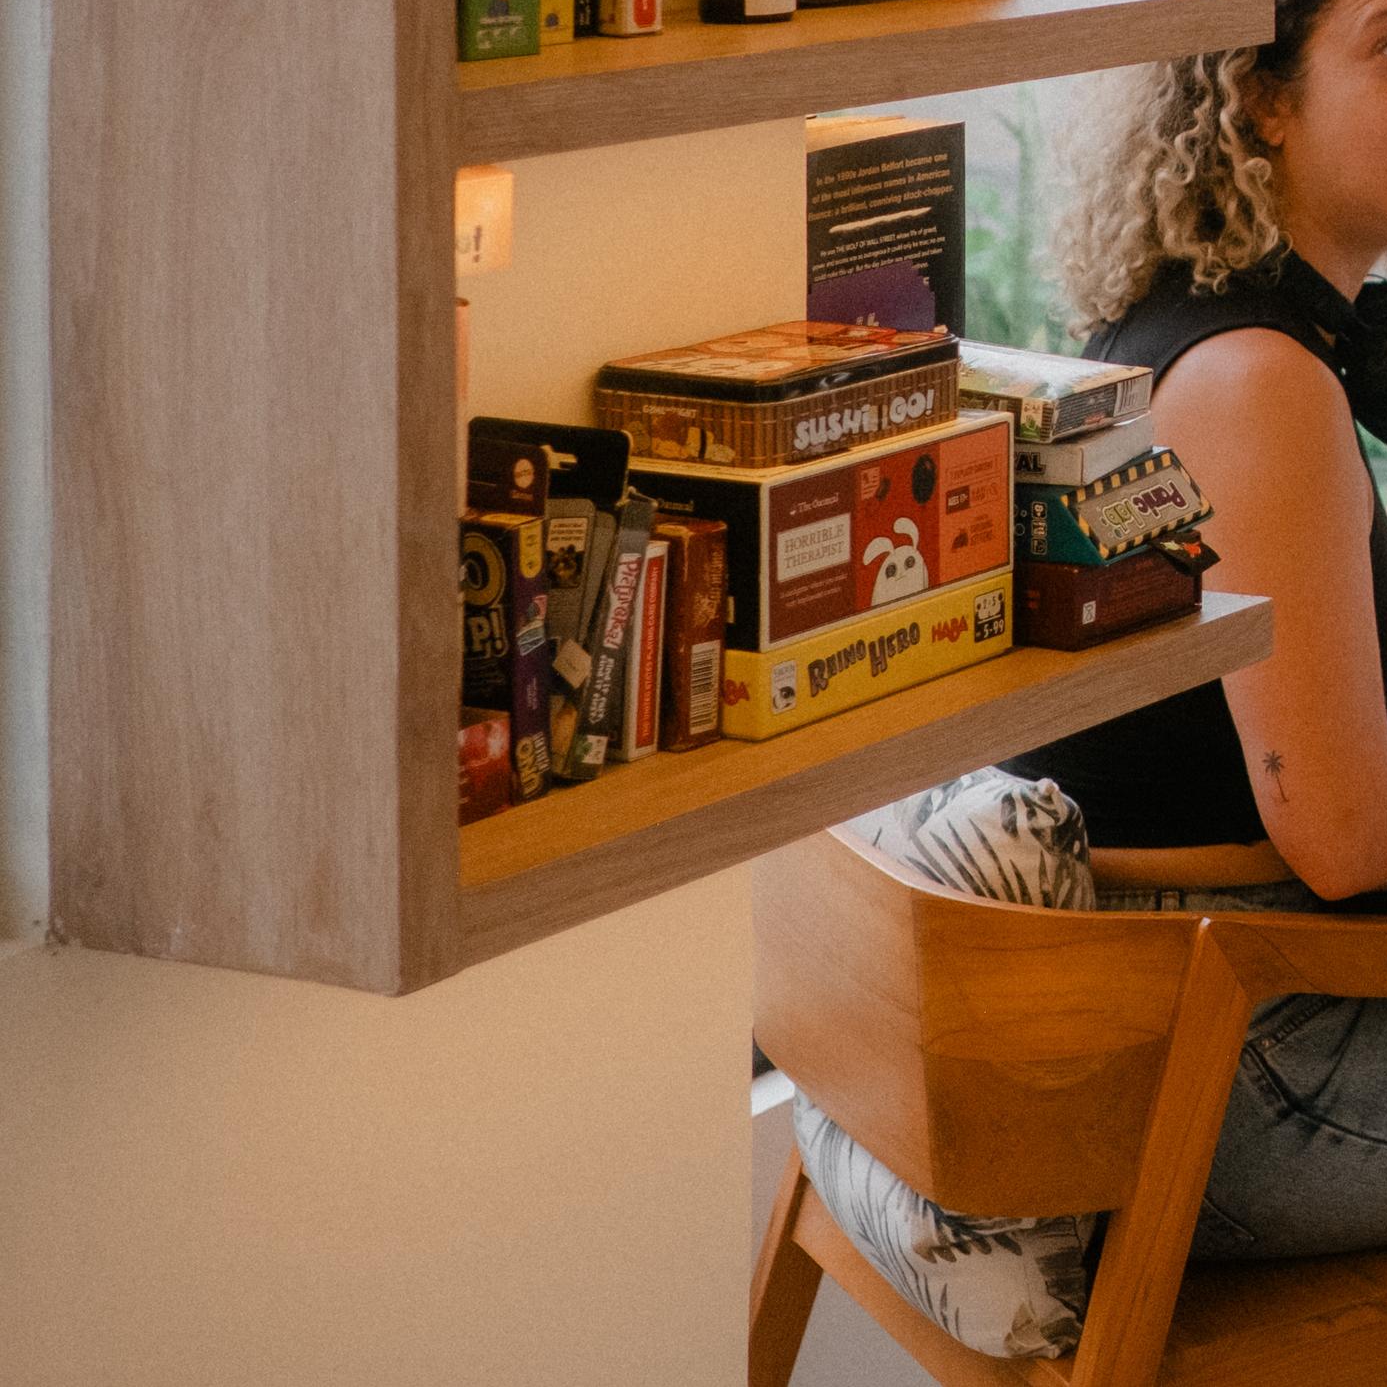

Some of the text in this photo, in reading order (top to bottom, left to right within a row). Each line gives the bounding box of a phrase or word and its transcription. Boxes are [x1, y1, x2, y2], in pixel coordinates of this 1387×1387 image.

[889, 388, 935, 424] GO!
[1132, 481, 1188, 518] Panic
[784, 541, 845, 569] THERAPIST
[785, 524, 845, 554] HORRIBLE
[931, 615, 969, 644] HABA
[808, 621, 921, 698] RHINO HERO
[515, 736, 544, 799] UNO
